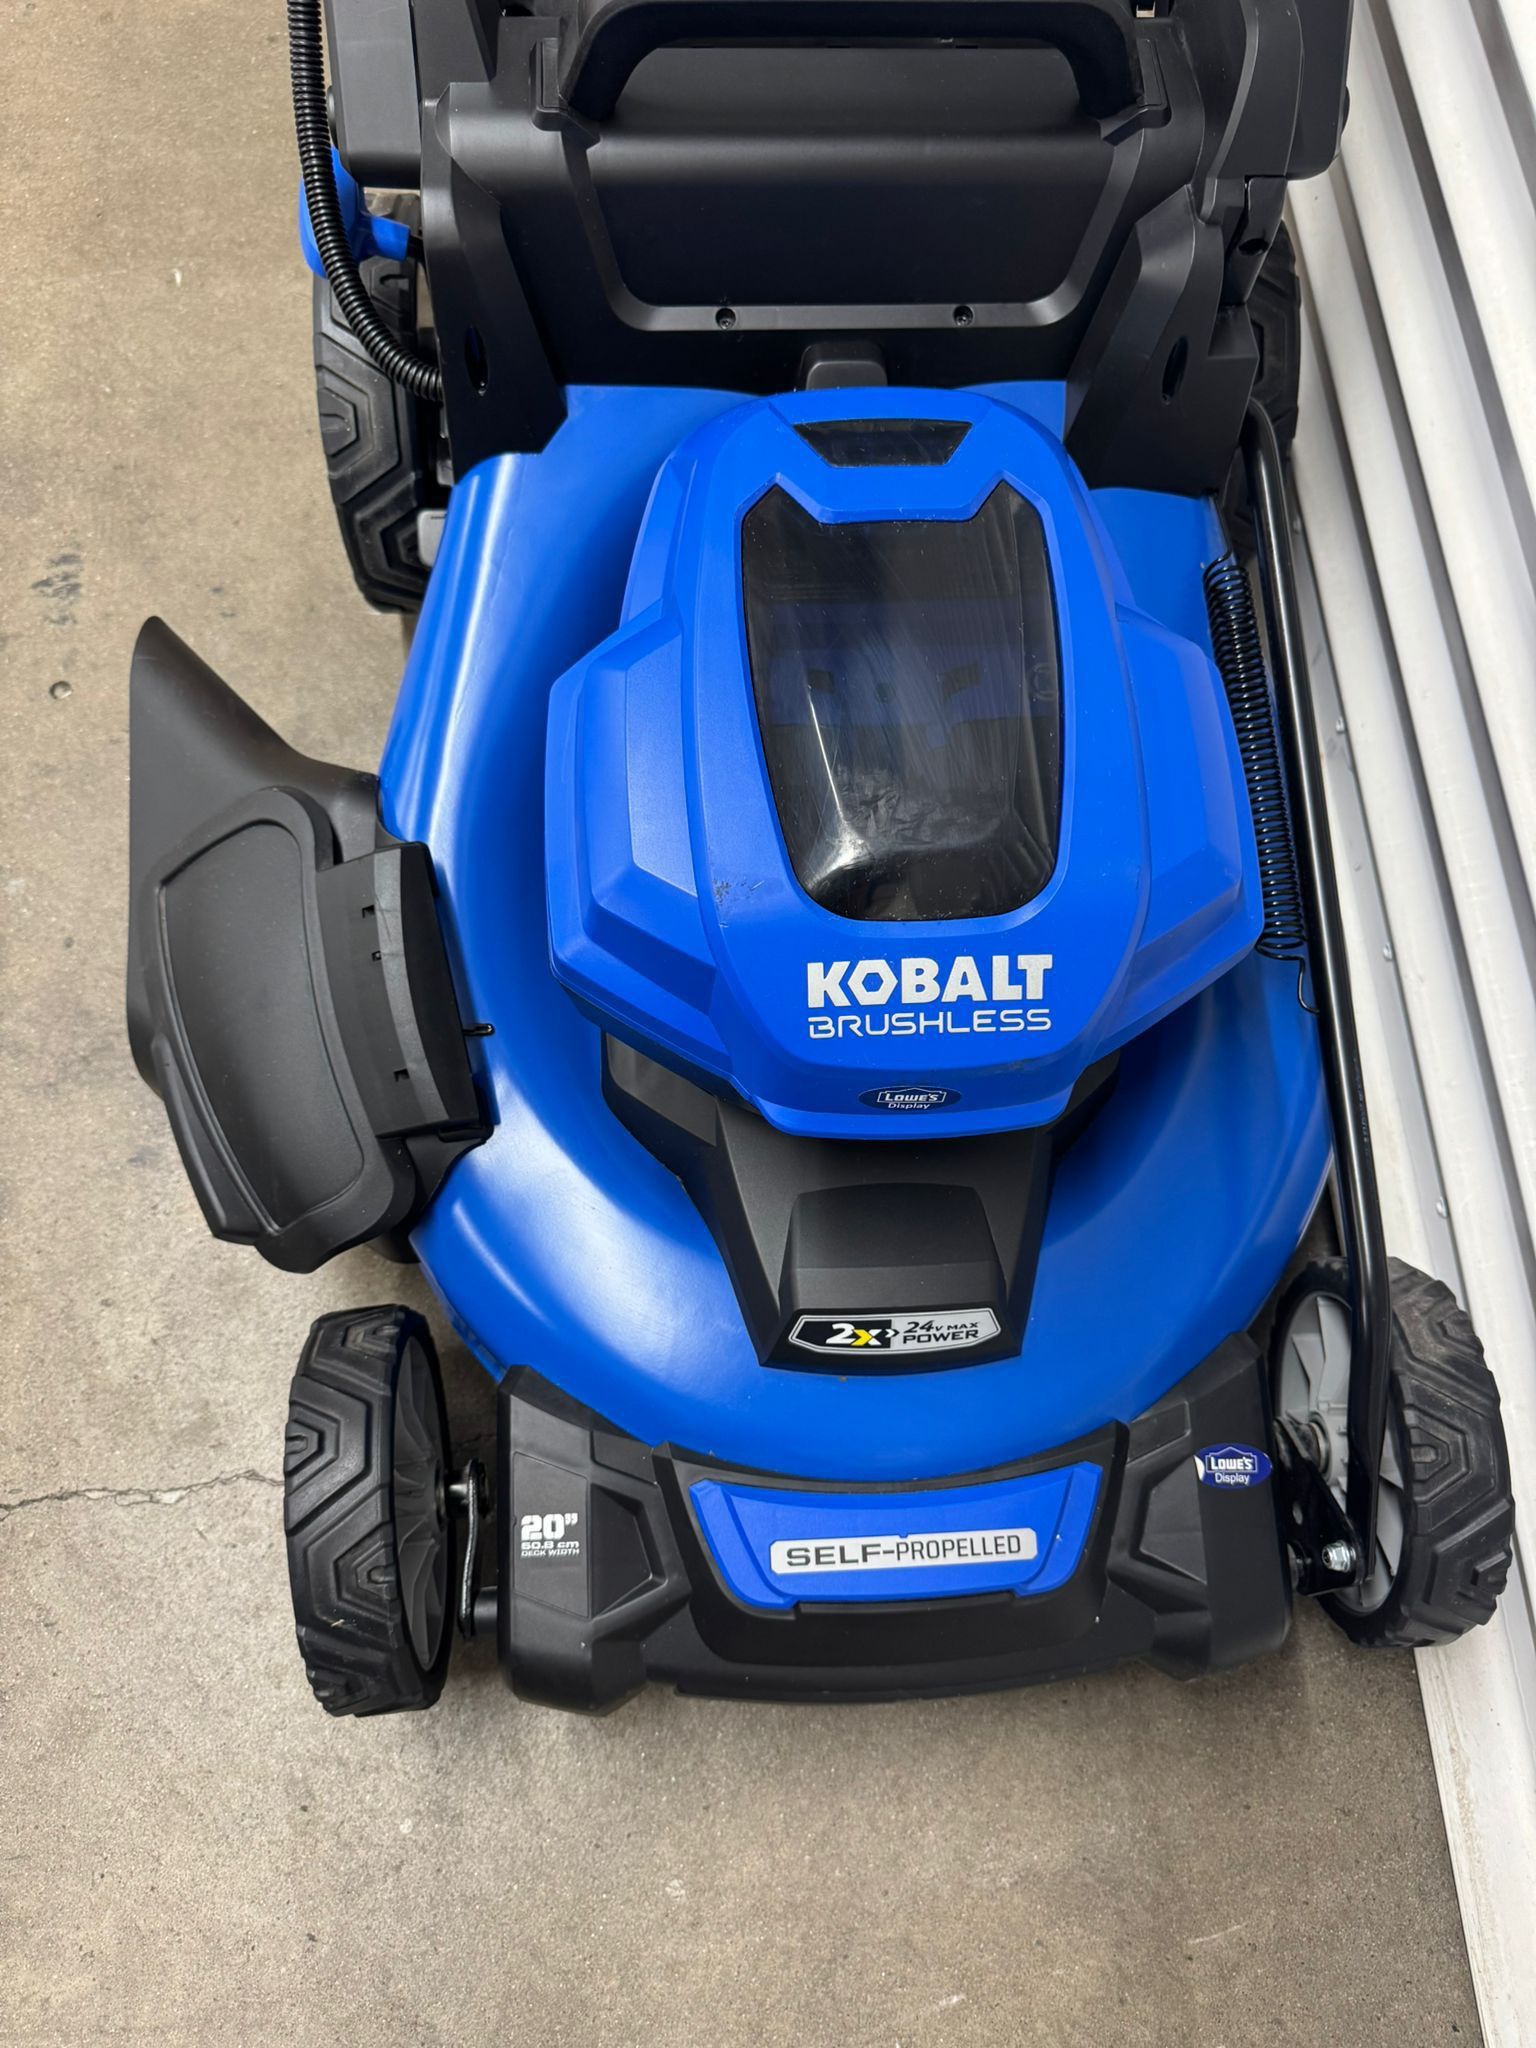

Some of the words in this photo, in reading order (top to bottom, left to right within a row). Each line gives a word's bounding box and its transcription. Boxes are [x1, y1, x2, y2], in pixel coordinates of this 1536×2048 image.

[807, 953, 1053, 1008] KOBALT
[807, 1009, 1052, 1039] BRUSHLESS
[946, 1322, 978, 1331] MAX
[903, 1329, 979, 1344] POWER
[1210, 1456, 1254, 1470] LOWE'S
[1214, 1473, 1250, 1486] Display
[521, 1541, 554, 1550] 50.8
[557, 1541, 580, 1549] cm
[548, 1548, 580, 1556] WIDTH
[786, 1534, 1021, 1567] SELF-PROPELLED
